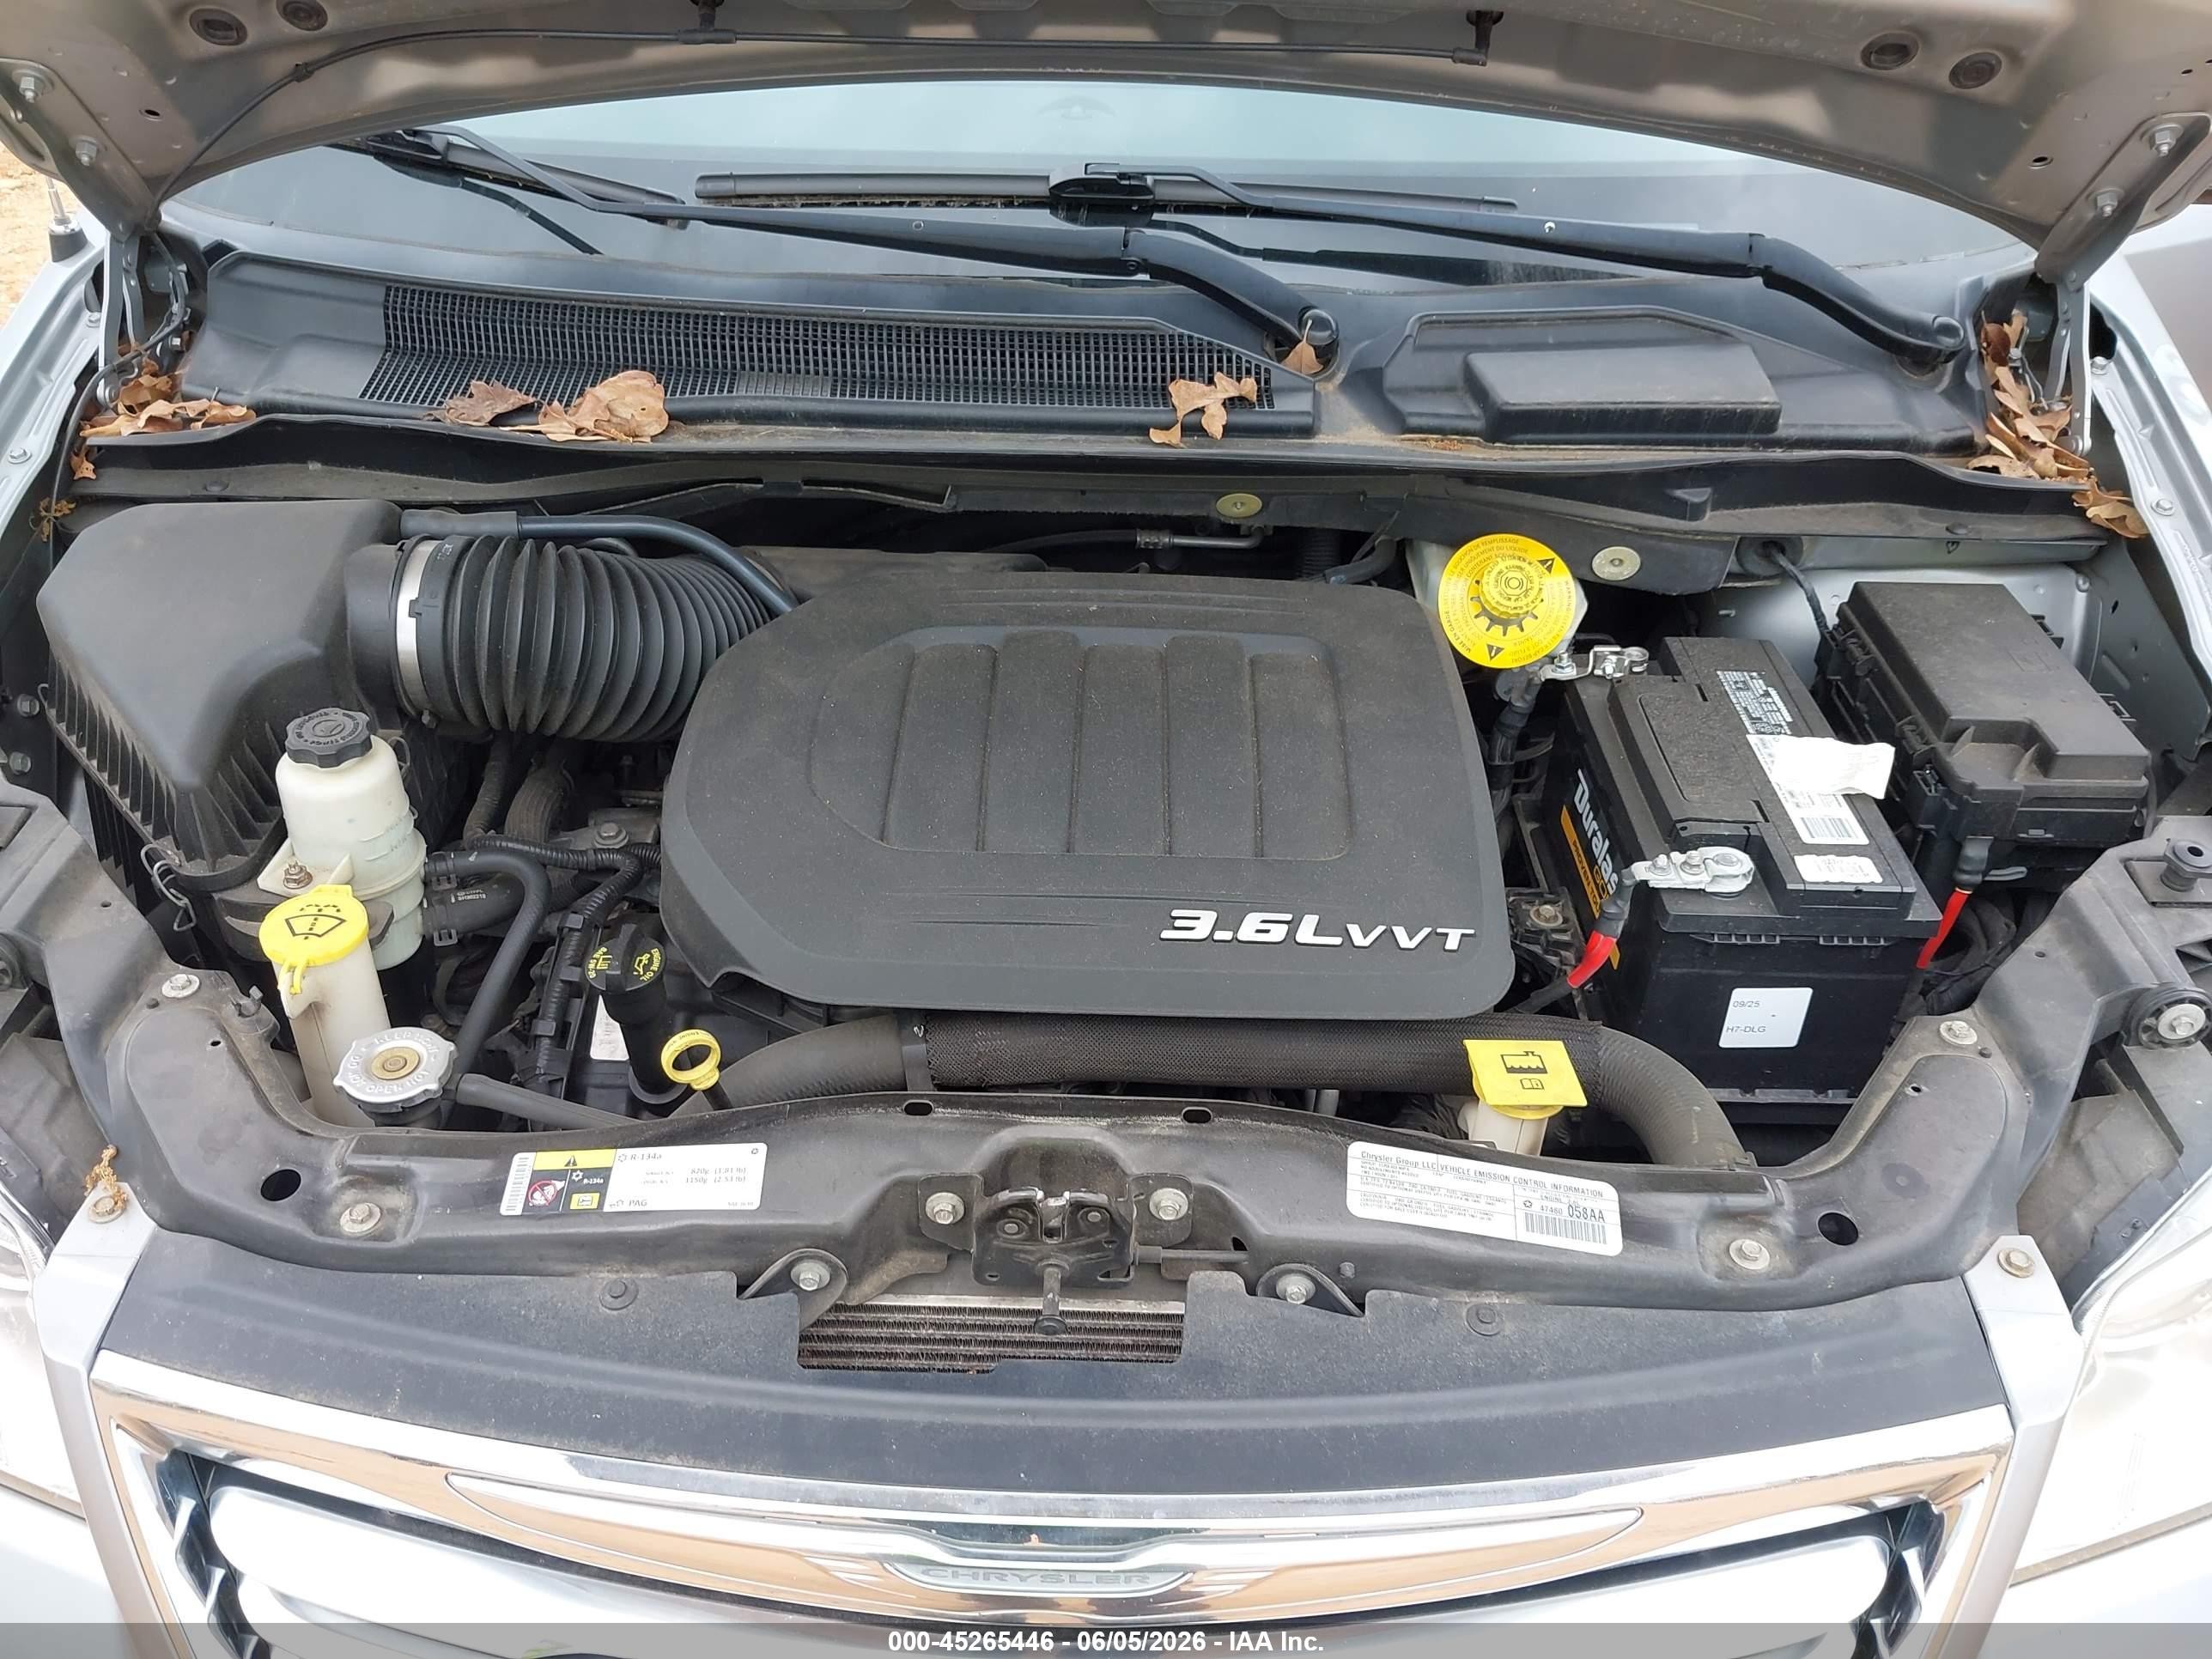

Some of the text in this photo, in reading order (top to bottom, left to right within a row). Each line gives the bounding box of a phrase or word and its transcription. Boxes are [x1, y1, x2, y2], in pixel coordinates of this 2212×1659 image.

[1573, 768, 1619, 896] Duralas
[1593, 864, 1609, 900] GO
[1159, 908, 1476, 952] 3.6L VVT
[640, 948, 661, 981] ENGINE OIL
[365, 1084, 403, 1094] OPEN
[1361, 1151, 1393, 1162] Chrysler
[1395, 1157, 1419, 1169] Group
[1440, 1164, 1471, 1176] VEHICLE
[1474, 1170, 1510, 1182] EMISSION
[1513, 1176, 1548, 1189] CONTROL
[1551, 1183, 1603, 1198] INFORMATION
[1567, 1204, 1606, 1223] 058AA
[921, 1568, 1151, 1585] CHRYSLER
